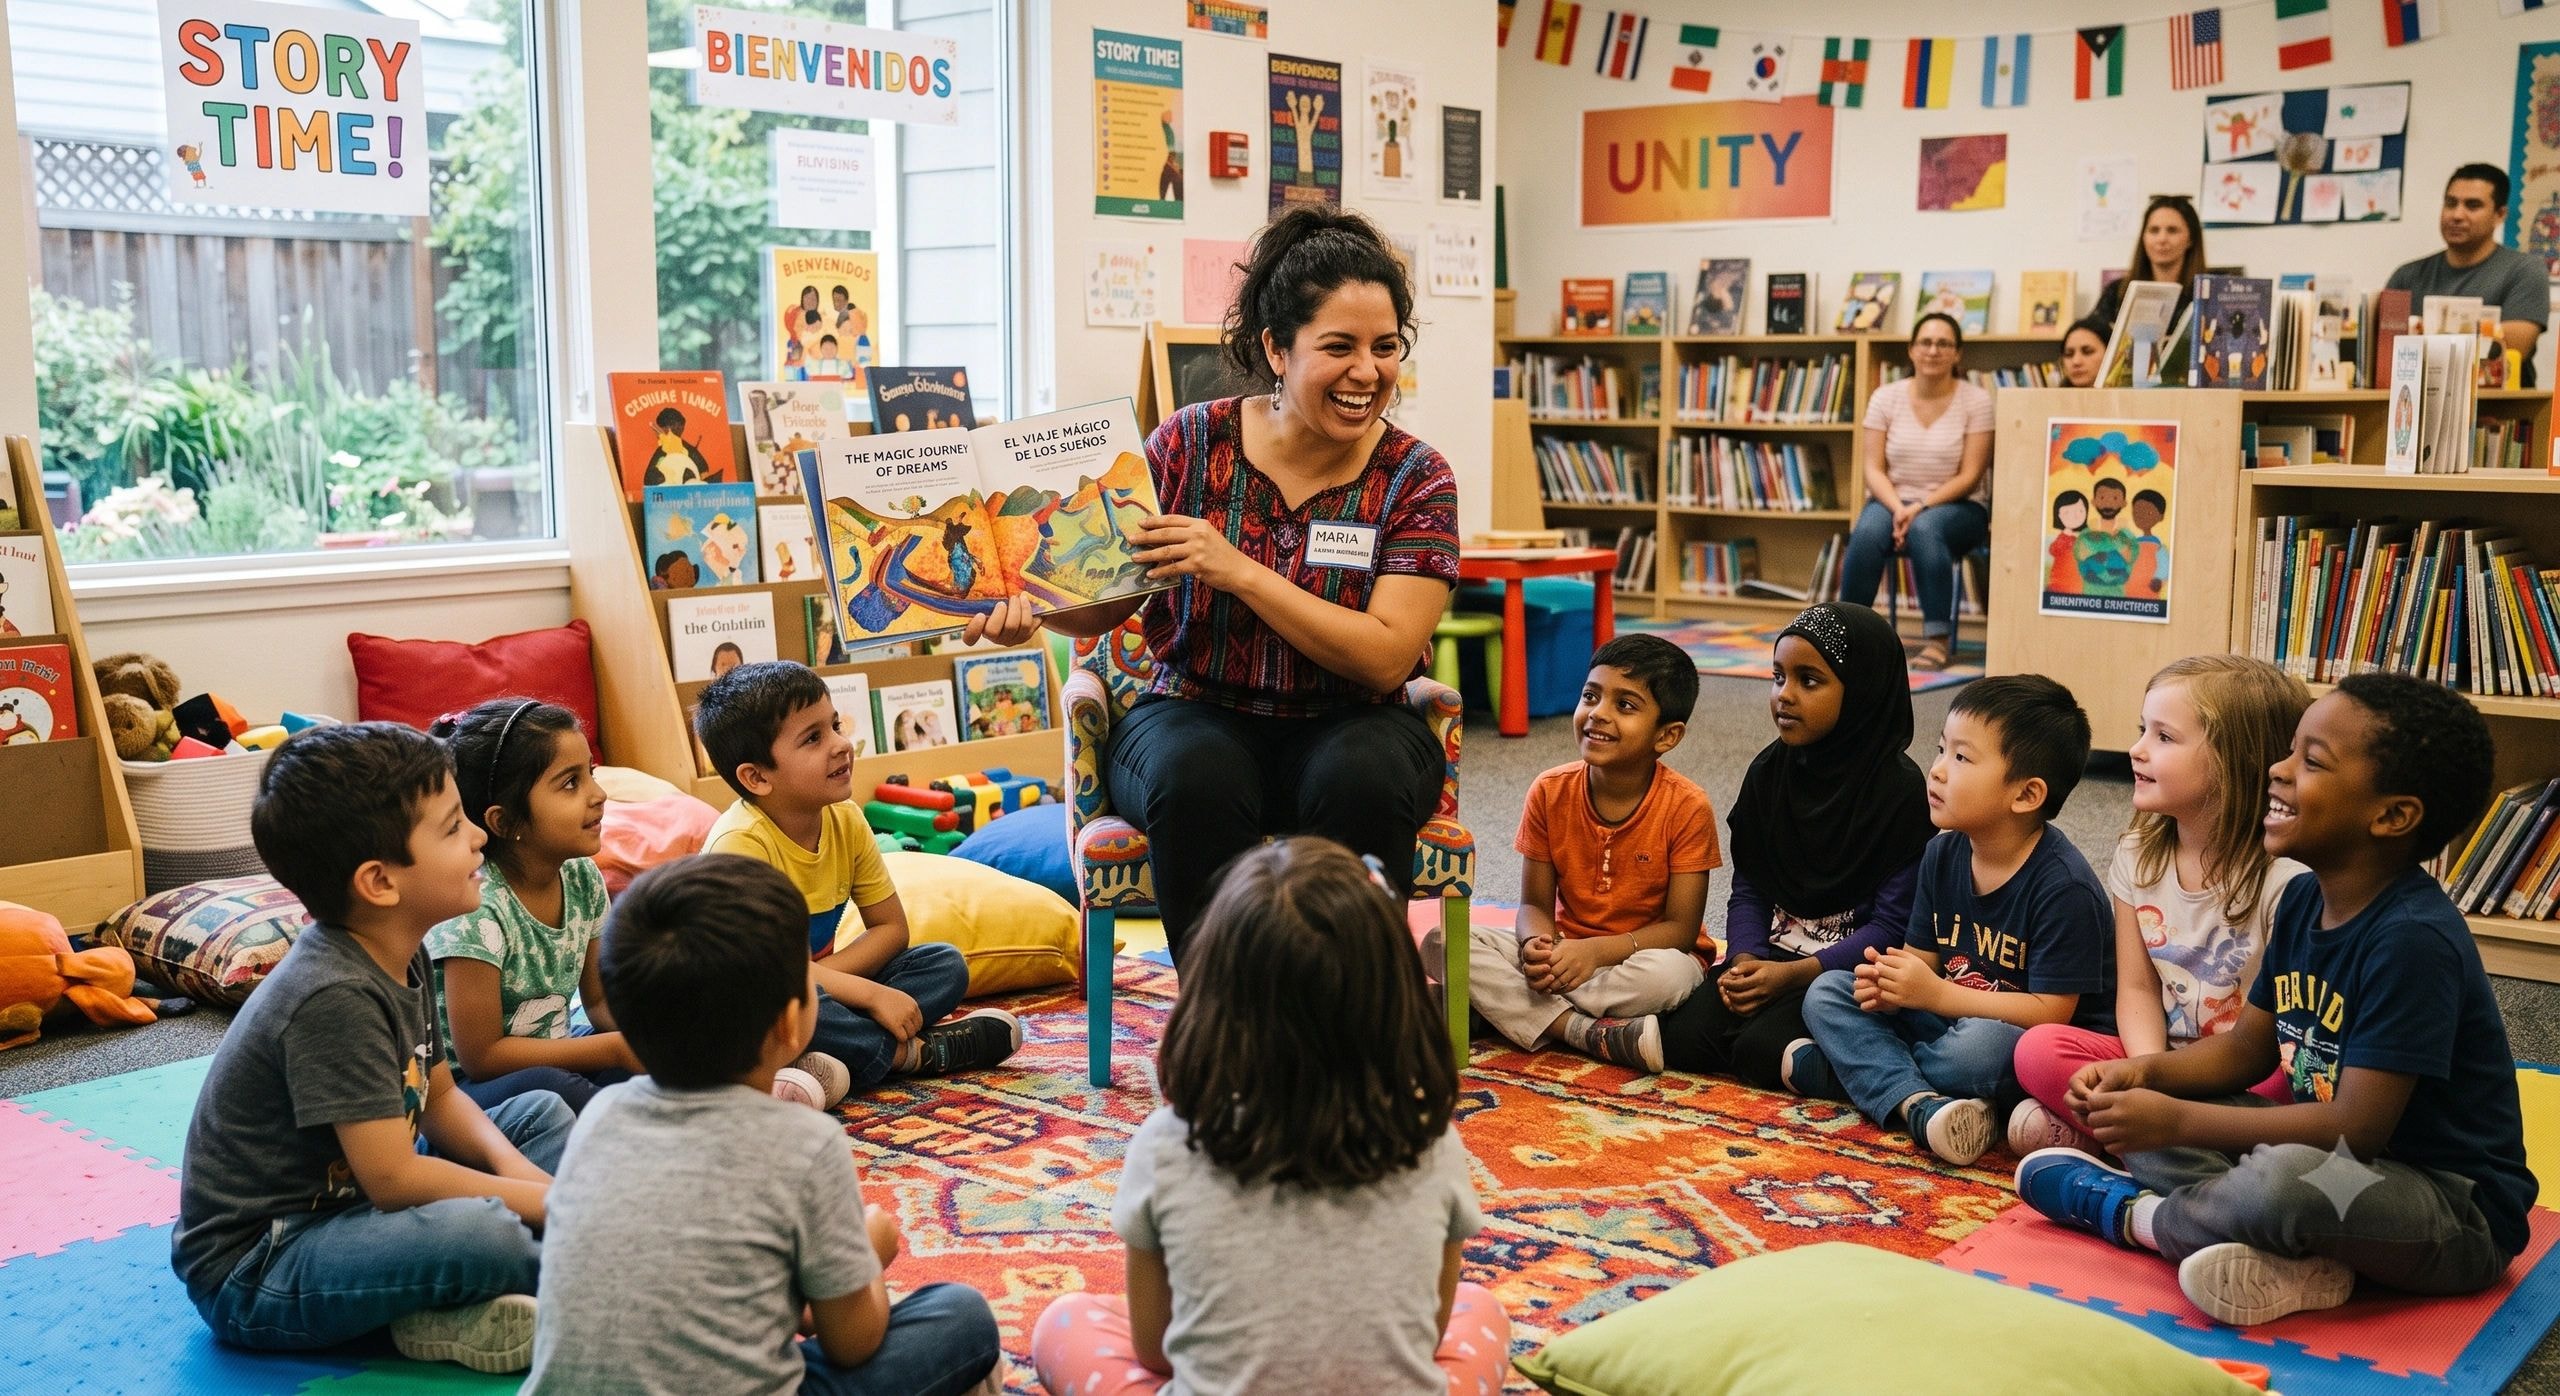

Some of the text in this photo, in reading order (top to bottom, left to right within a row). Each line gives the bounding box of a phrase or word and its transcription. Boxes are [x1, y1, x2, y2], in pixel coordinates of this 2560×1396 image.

[179, 19, 411, 102] STORY
[707, 30, 951, 98] BIENVENIDOS
[1097, 40, 1141, 63] STORY
[203, 101, 404, 179] TIME!
[1608, 132, 1804, 194] UNITY
[782, 257, 871, 282] BIENVENIDOS
[1004, 419, 1111, 449] EL VIAJE MÁGICO
[845, 444, 968, 465] THE MAGIC JOURNEY
[1015, 450, 1032, 462] DE
[1034, 444, 1057, 458] LOS
[876, 460, 948, 477] OF DREAMS
[1315, 531, 1359, 545] MARIA
[684, 622, 708, 635] the
[1973, 922, 2027, 970] WEI
